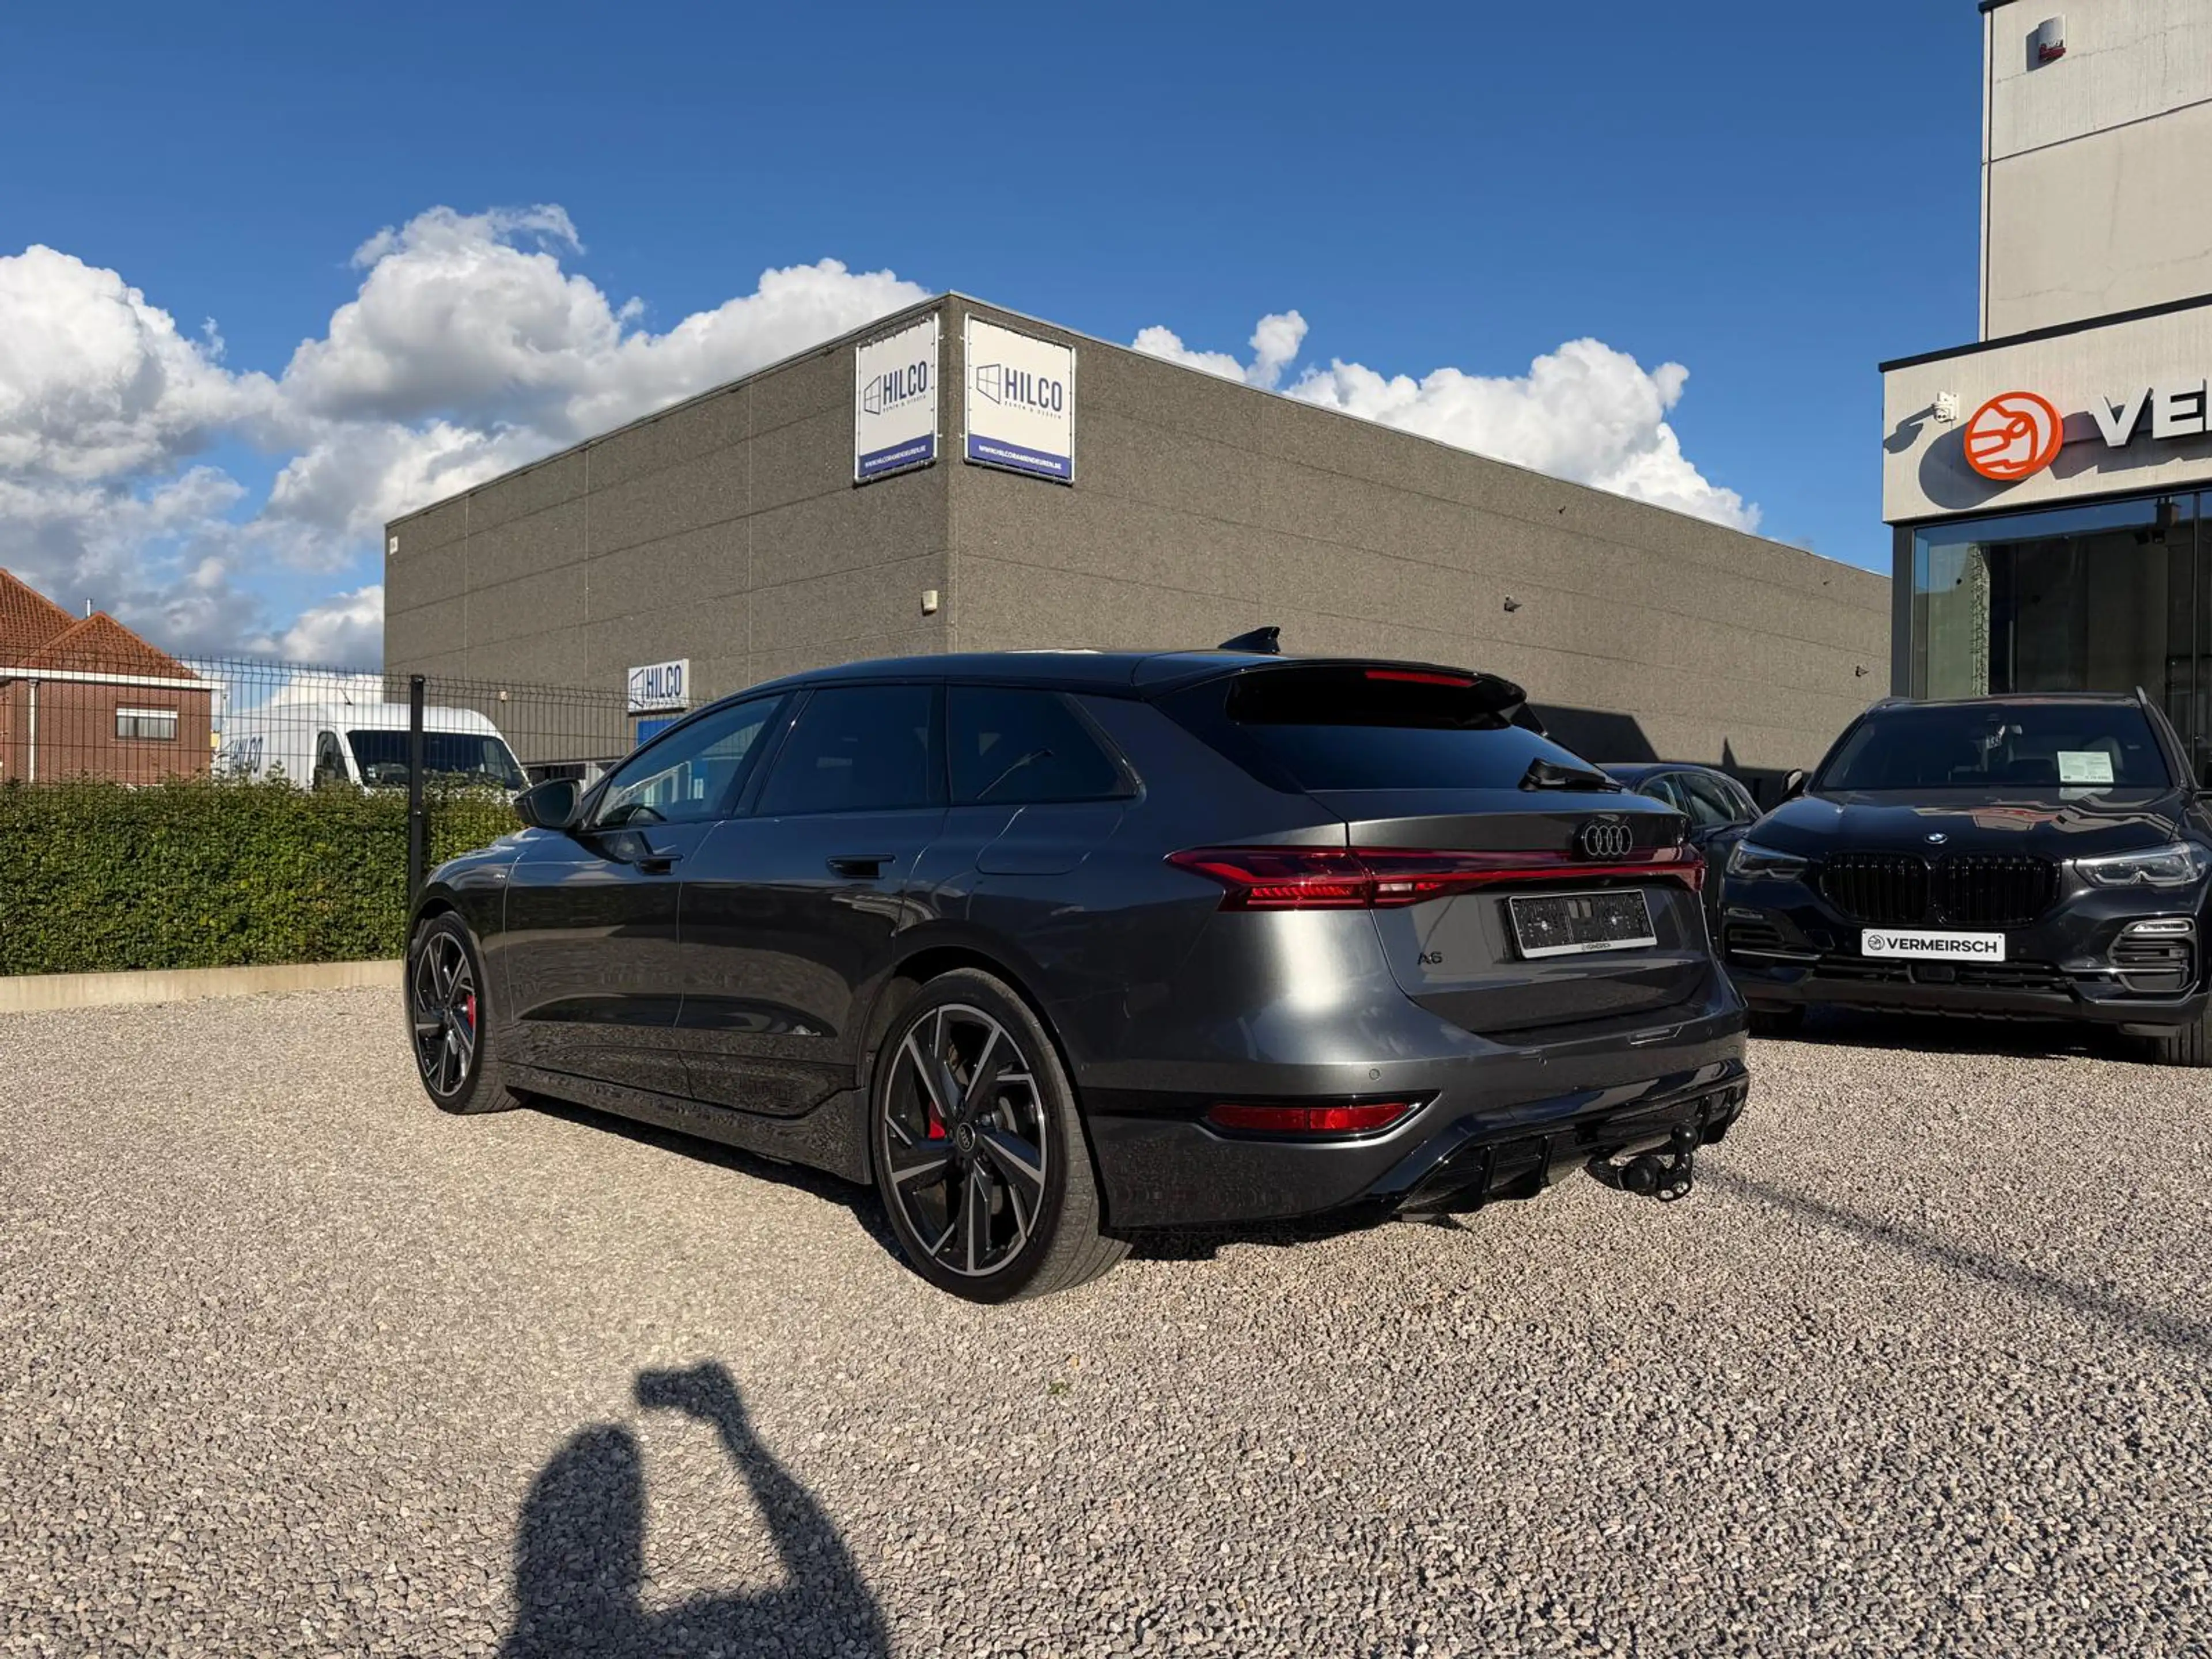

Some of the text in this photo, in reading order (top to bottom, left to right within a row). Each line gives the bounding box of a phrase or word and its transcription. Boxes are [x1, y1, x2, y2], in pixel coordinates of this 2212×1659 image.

[883, 361, 927, 405] HILCO
[1005, 368, 1062, 412] HILCO
[646, 665, 681, 699] HILCO
[1417, 951, 1443, 965] A6
[1886, 937, 1998, 953] VERMEIRSCH
